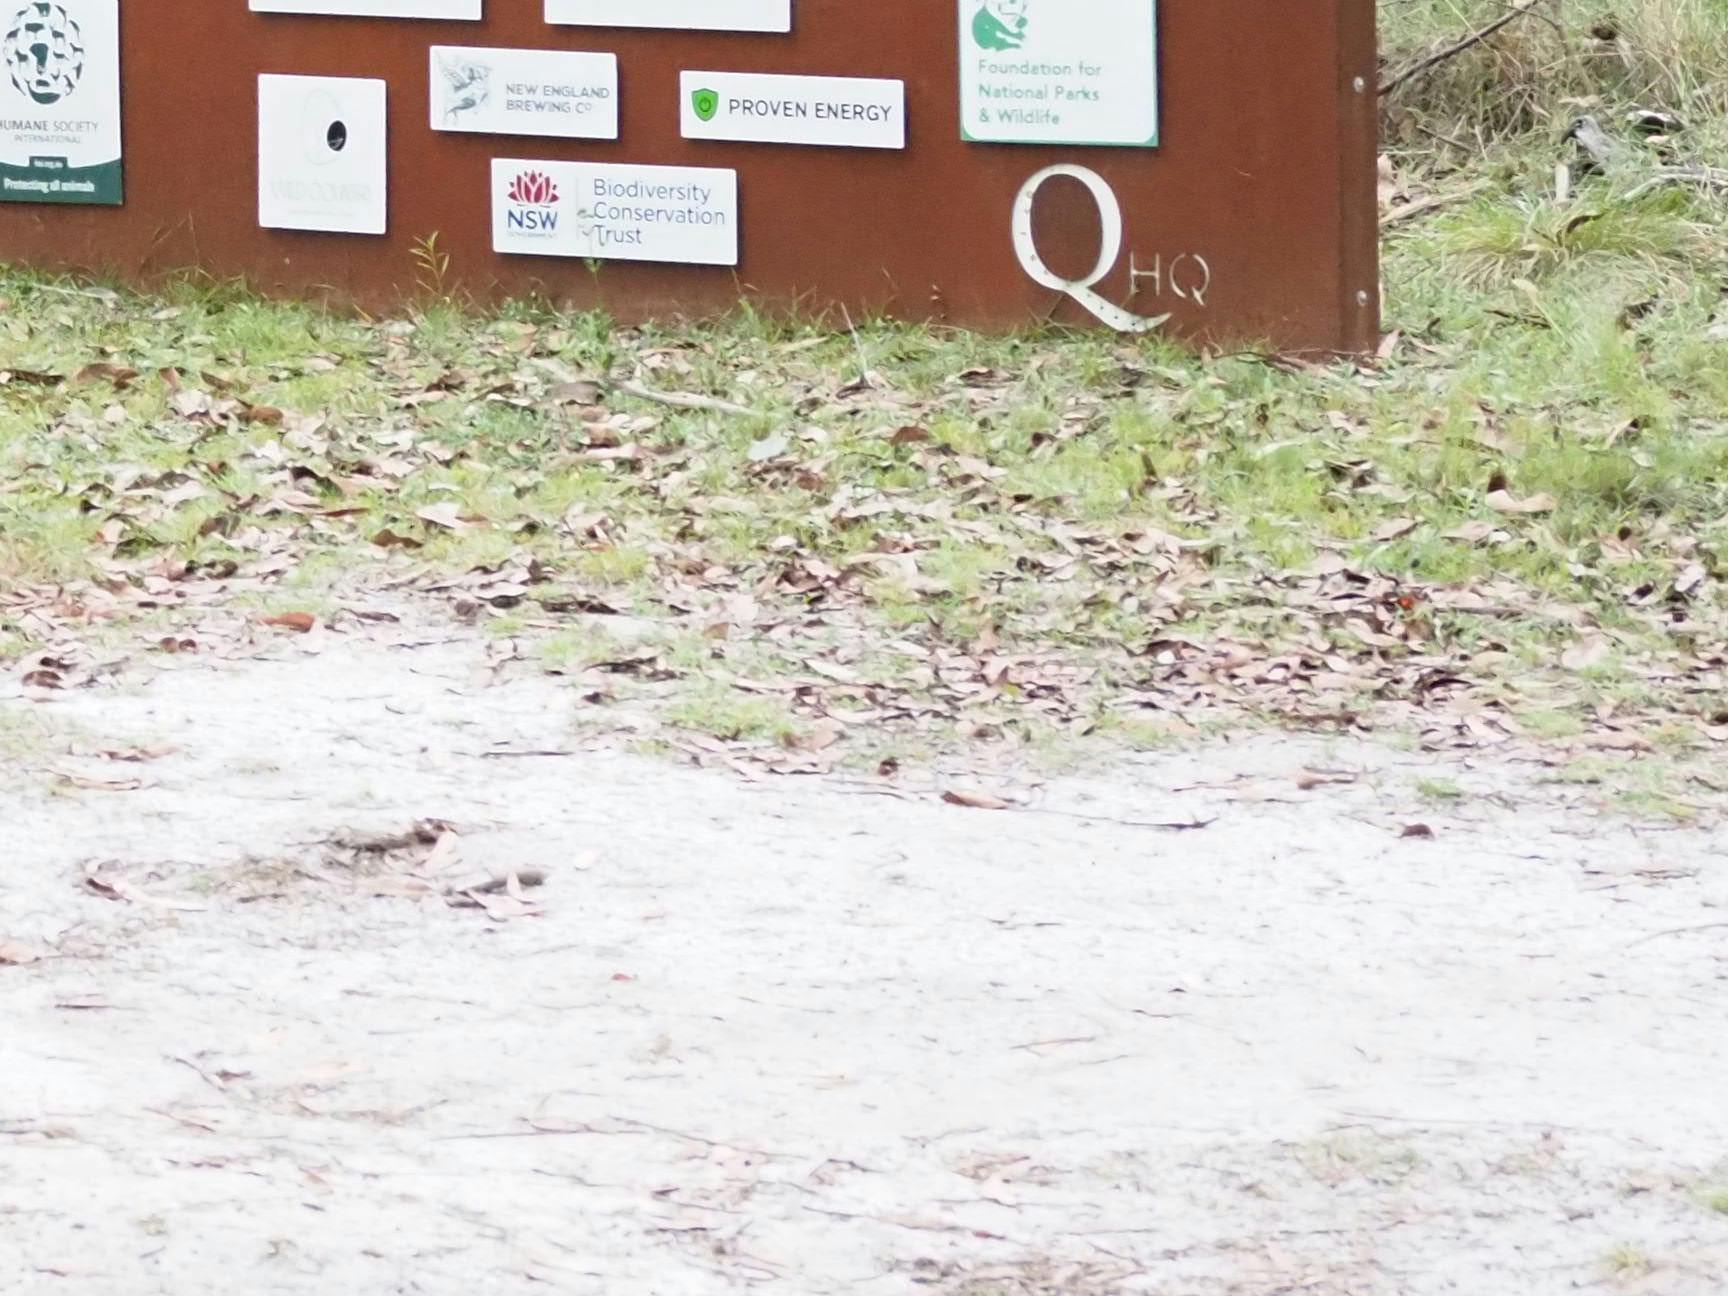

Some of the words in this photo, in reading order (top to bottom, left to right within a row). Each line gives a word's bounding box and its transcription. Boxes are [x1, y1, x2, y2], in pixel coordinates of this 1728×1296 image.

[978, 59, 1072, 76] Foundation
[1079, 60, 1102, 76] for
[506, 83, 539, 96] NEW
[543, 84, 610, 99] ENGLAND
[978, 83, 1048, 100] National
[1055, 85, 1100, 101] Parks
[506, 100, 571, 114] BREWING
[728, 98, 807, 119] PROVEN
[815, 102, 893, 122] ENERGY
[979, 107, 990, 122] &
[998, 108, 1060, 124] Wildlife
[53, 120, 99, 132] SOCIETY
[594, 178, 711, 202] Biodiversity
[507, 209, 558, 231] NSW
[592, 201, 725, 225] Conservation
[593, 224, 642, 246] Trust
[1012, 163, 1173, 333] Q
[1130, 250, 1210, 306] HQ
